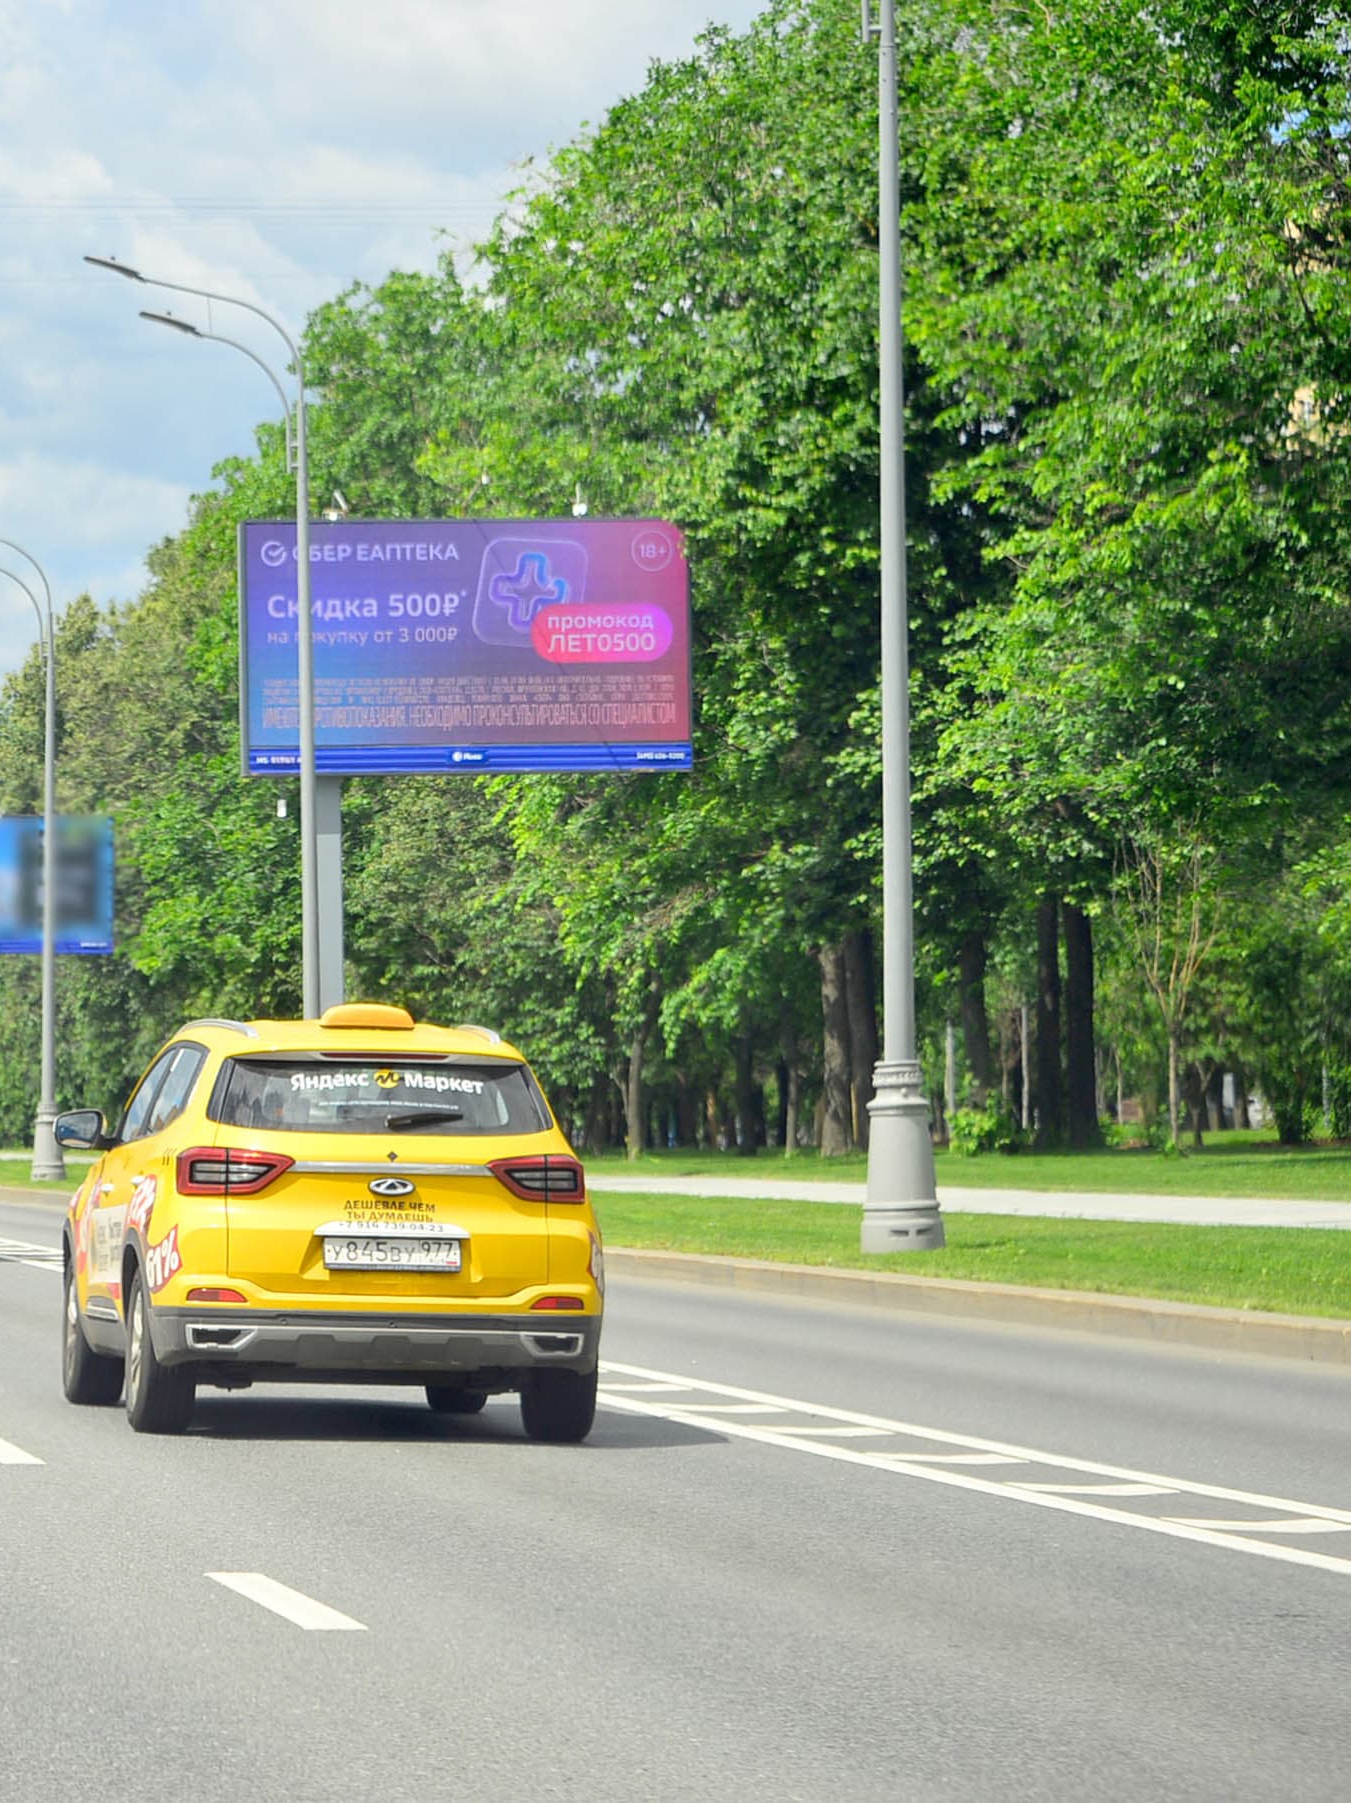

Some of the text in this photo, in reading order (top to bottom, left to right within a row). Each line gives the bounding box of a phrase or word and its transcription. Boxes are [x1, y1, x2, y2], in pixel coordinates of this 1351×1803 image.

[356, 543, 459, 561] ЕАПТЕКА
[638, 543, 667, 559] 18+
[547, 615, 654, 632] промокод
[267, 631, 289, 644] на
[294, 630, 369, 647] купку
[373, 630, 394, 643] от
[548, 633, 656, 653] ЛЕТО500
[290, 1073, 484, 1095] Яндекс Маркет
[344, 1200, 435, 1213] ДЕШЕВЛЕ ЧЕМ
[346, 1211, 434, 1223] ТЫ ДУМАЕШЬ
